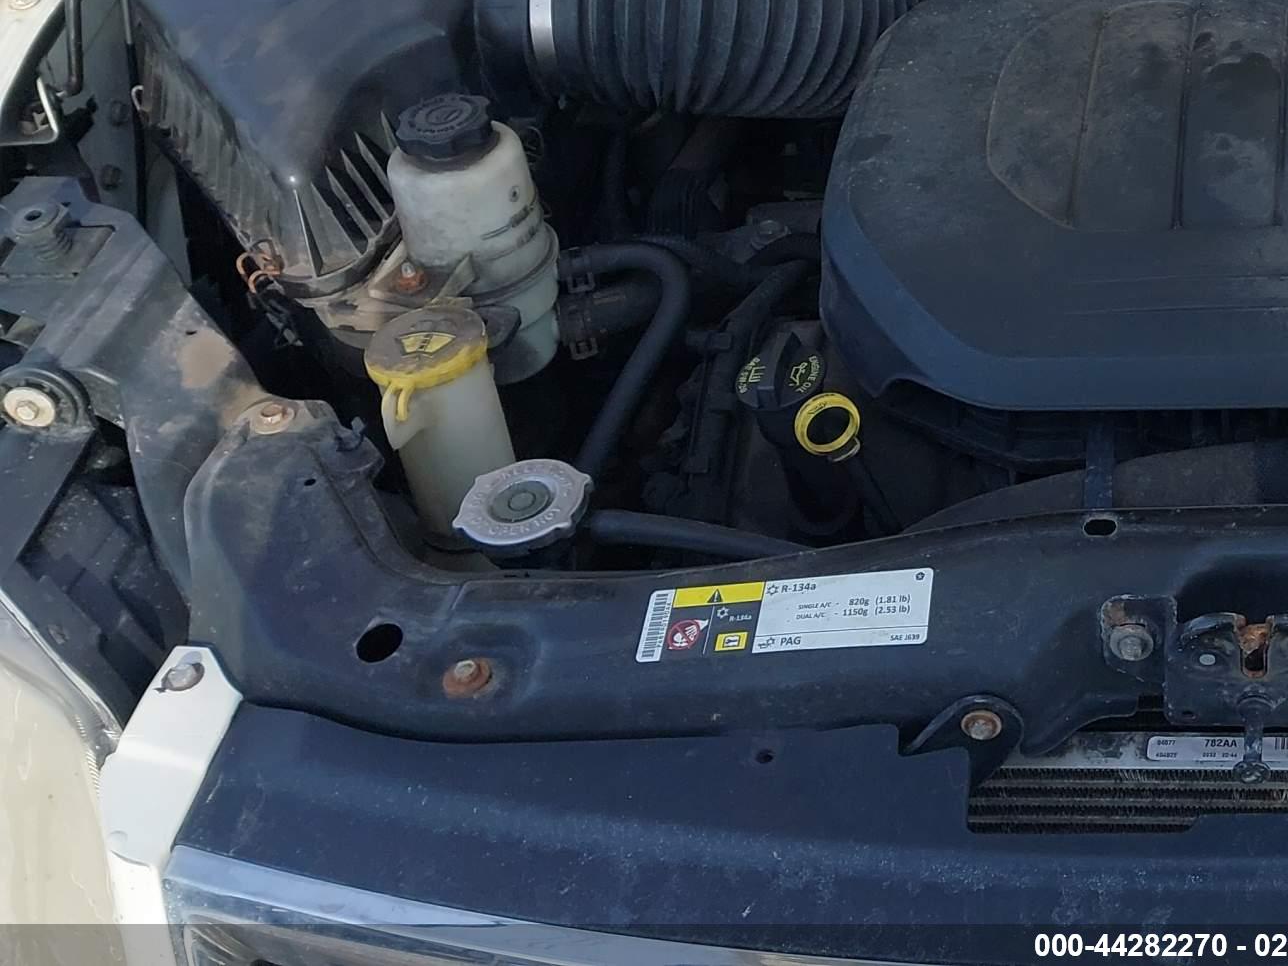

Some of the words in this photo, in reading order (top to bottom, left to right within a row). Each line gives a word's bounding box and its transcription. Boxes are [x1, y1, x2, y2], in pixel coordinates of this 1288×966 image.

[796, 382, 811, 393] OIL
[781, 582, 816, 593] R-134a
[820, 601, 832, 609] A/C
[848, 597, 870, 607] 820g
[875, 595, 897, 605] (1.81
[899, 594, 911, 604] lb)
[843, 608, 869, 617] 1150g
[874, 605, 897, 615] (2.53
[898, 604, 911, 614] lb)
[780, 636, 801, 646] PAG
[1205, 739, 1237, 748] 782AA
